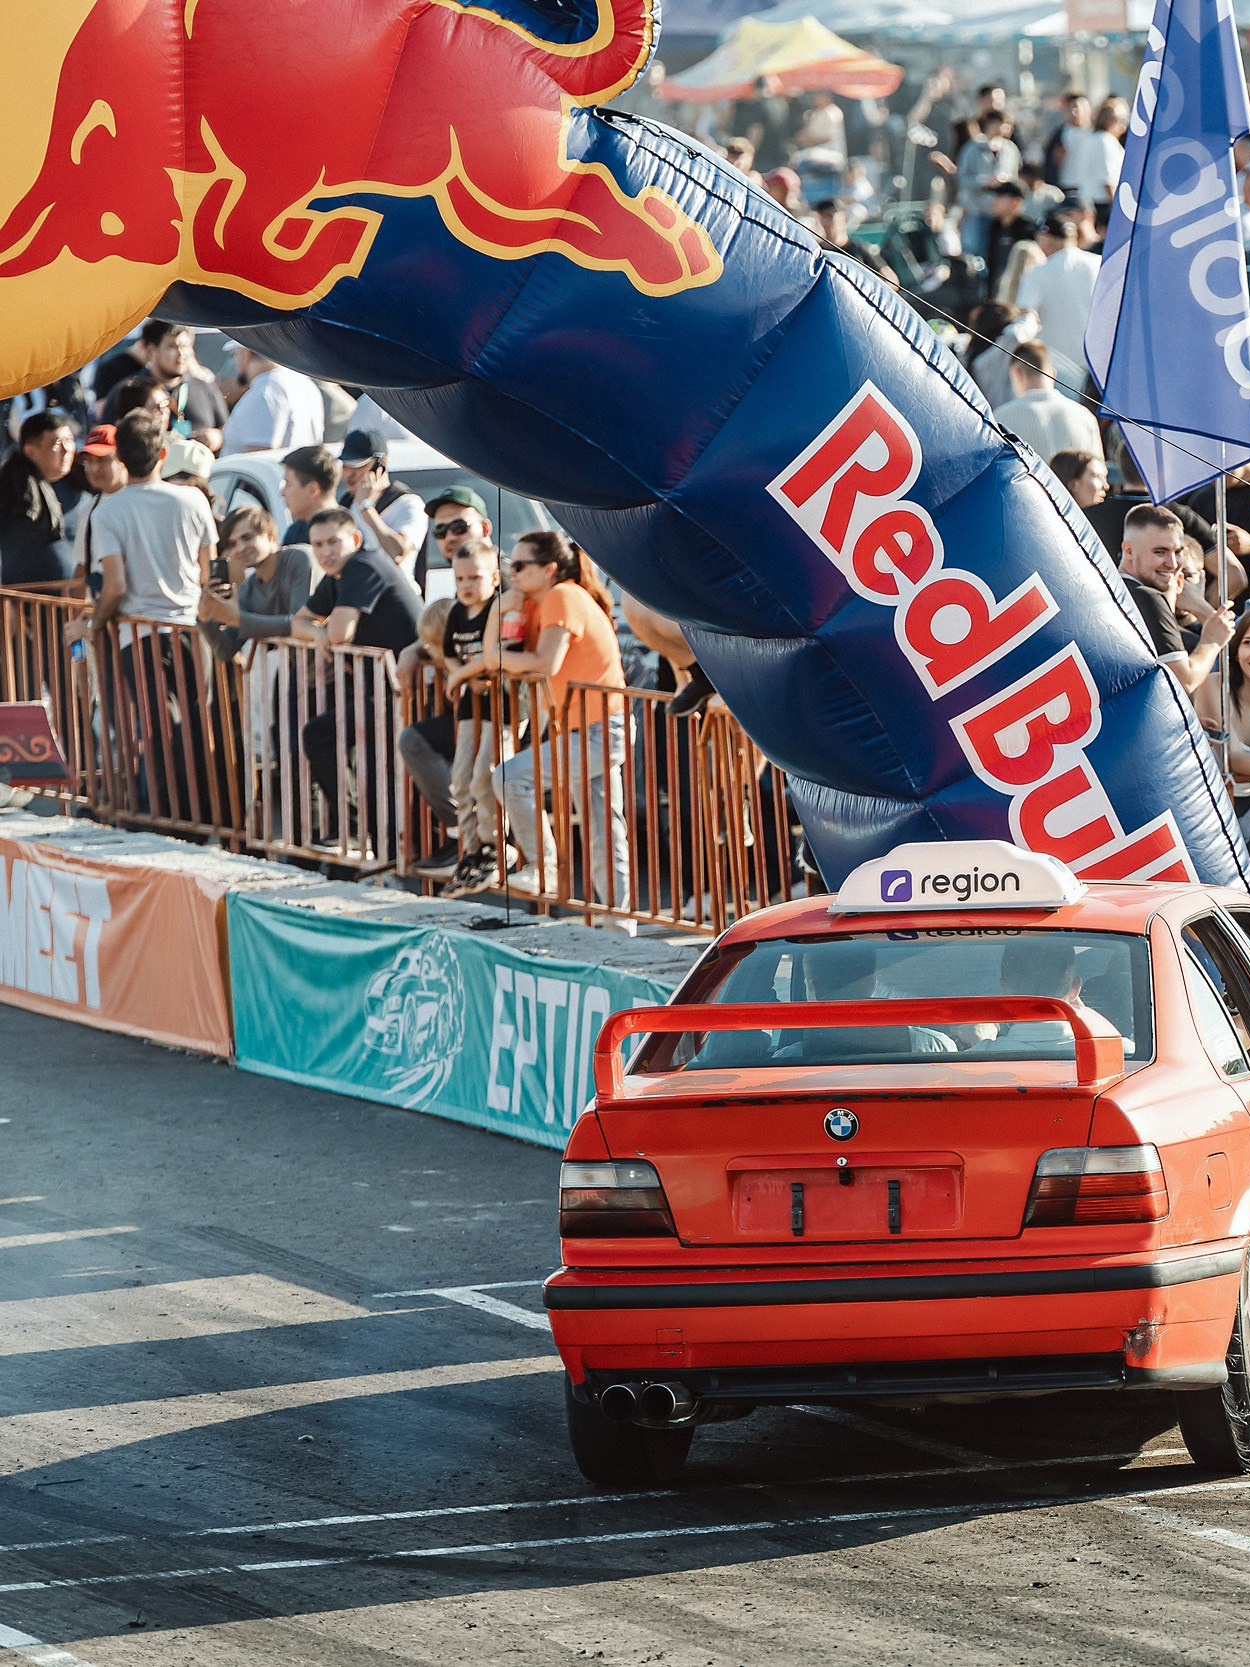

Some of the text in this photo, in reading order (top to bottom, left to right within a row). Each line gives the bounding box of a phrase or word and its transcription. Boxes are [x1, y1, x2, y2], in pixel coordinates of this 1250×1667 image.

[774, 386, 1055, 694] Red
[0, 854, 112, 1010] MEET
[921, 866, 1020, 902] region
